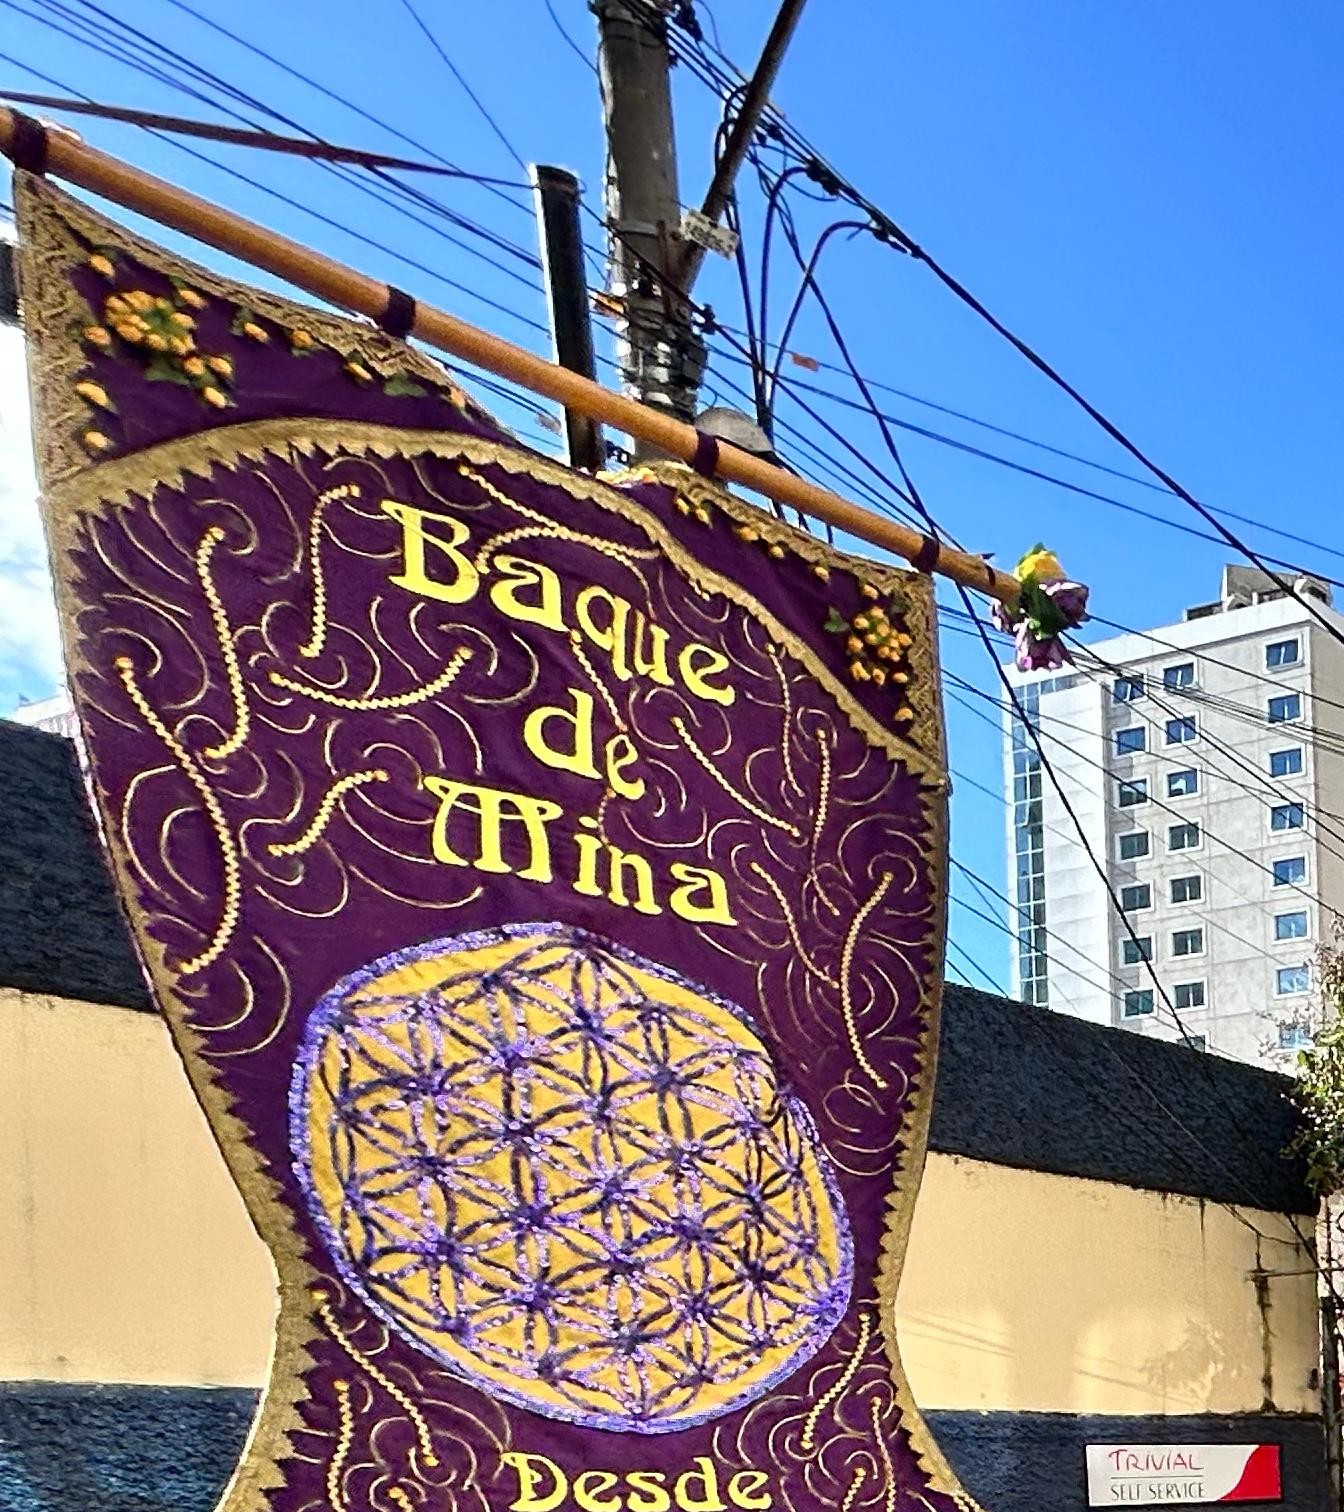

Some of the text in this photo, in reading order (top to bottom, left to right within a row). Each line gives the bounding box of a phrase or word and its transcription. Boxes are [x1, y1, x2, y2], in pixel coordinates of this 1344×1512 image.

[380, 499, 736, 706] Baque
[523, 688, 646, 800] de
[424, 776, 738, 926] Mina
[1107, 1448, 1205, 1472] TRIVIAL
[1110, 1481, 1205, 1501] SELF SERVICE
